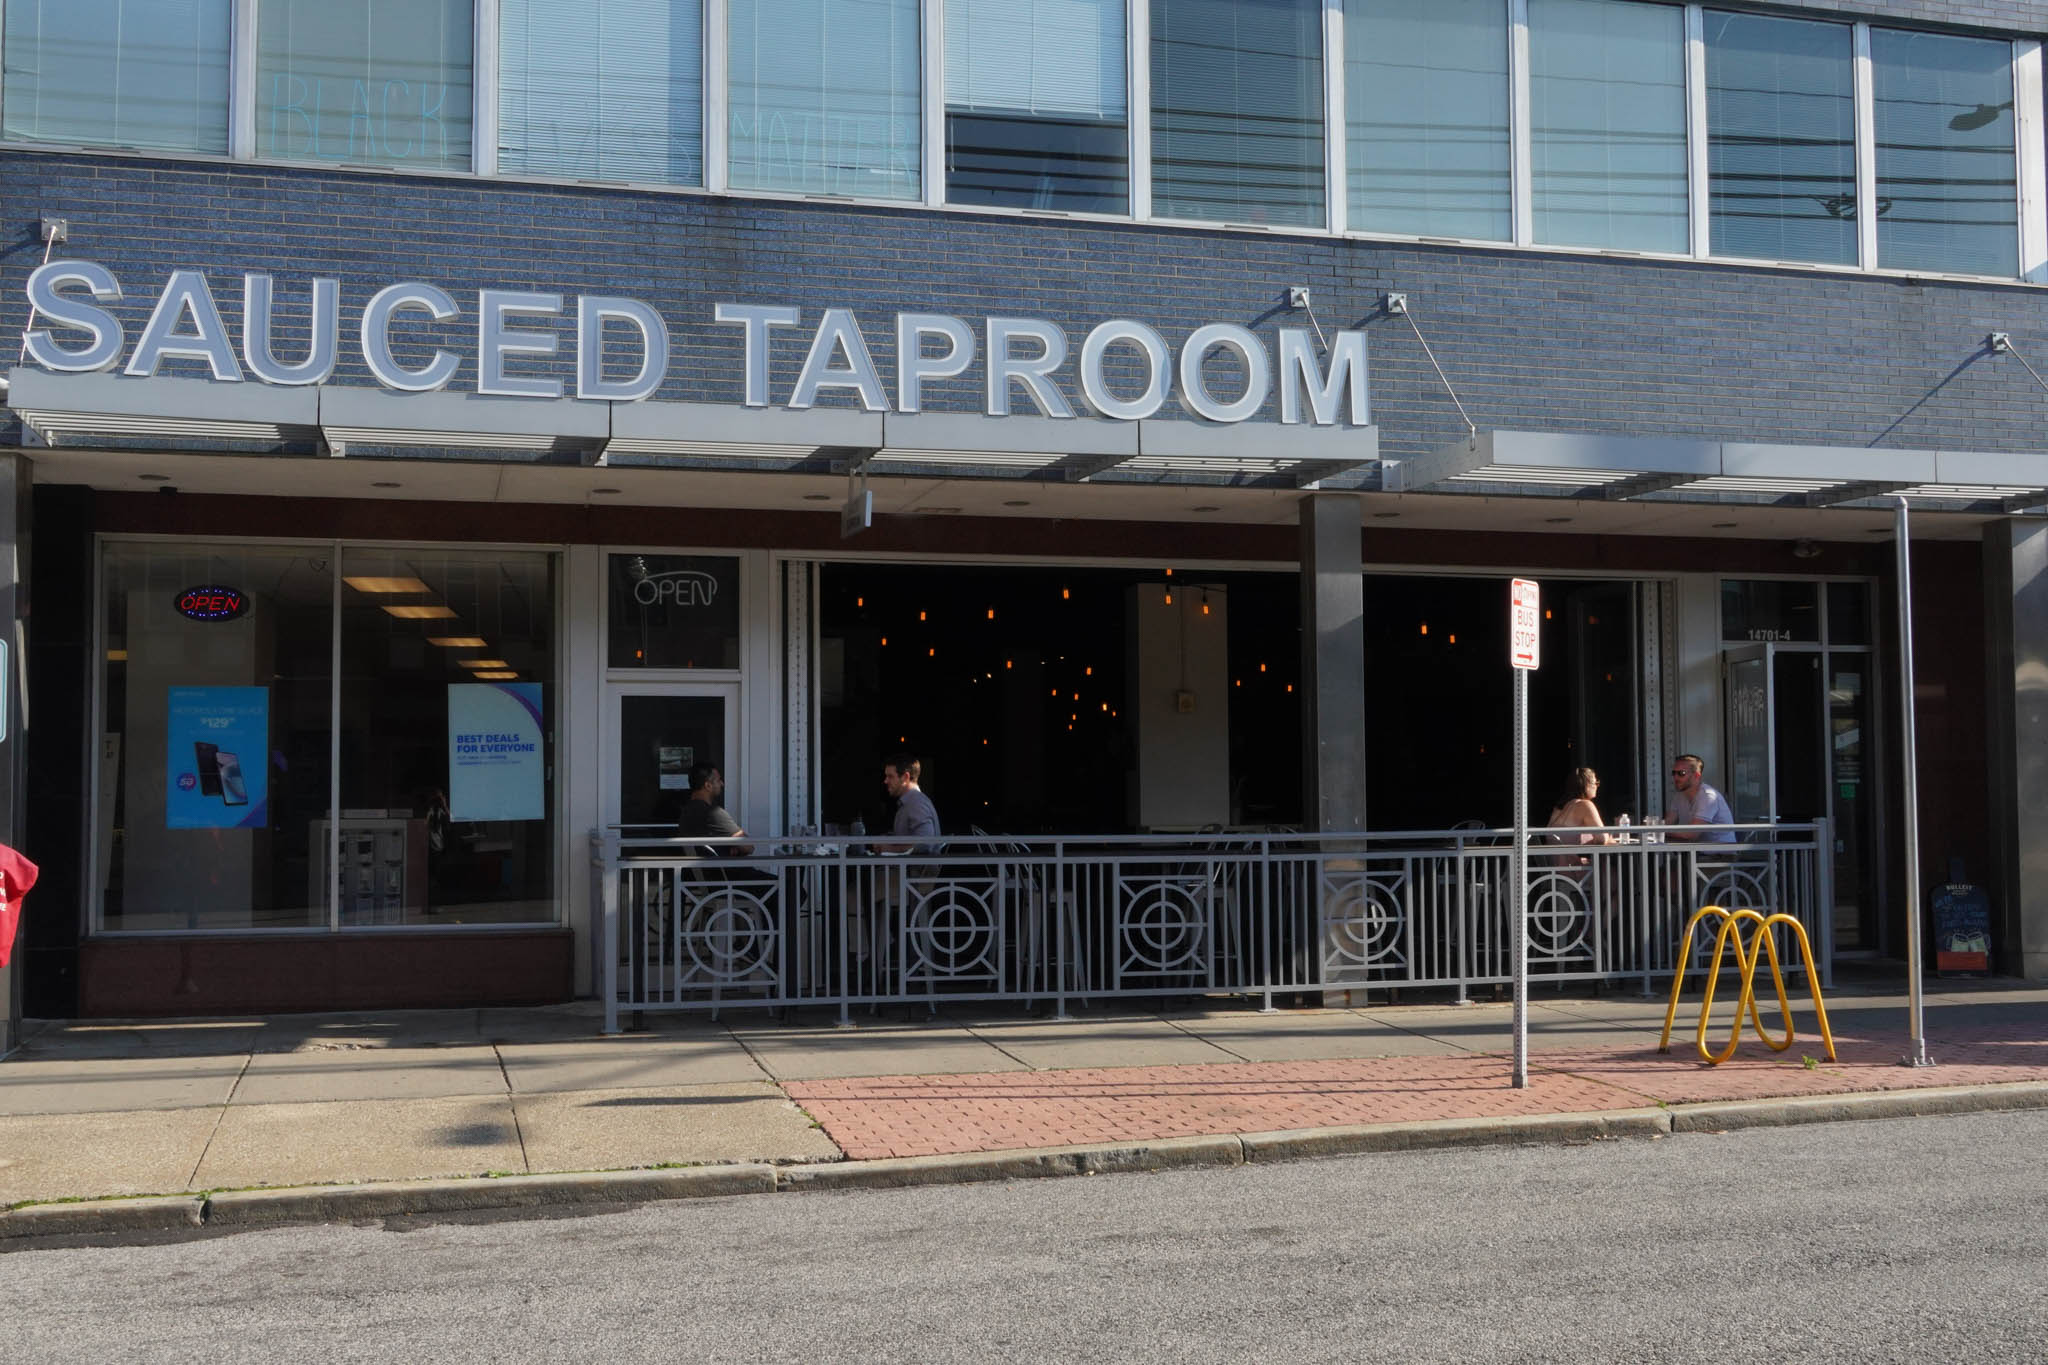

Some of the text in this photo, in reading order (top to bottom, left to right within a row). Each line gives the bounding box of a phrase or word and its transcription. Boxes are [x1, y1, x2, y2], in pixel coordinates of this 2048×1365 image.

[272, 72, 448, 161] BLACK
[23, 260, 1370, 427] SAUCED TAPROOM
[634, 578, 714, 606] OPEN
[181, 596, 240, 611] OPEN
[1517, 609, 1534, 627] BUS
[1515, 631, 1536, 648] STOP
[1748, 629, 1791, 641] 14701-4
[457, 734, 520, 743] BEST DEALS
[457, 744, 535, 754] FOR EVERYONE
